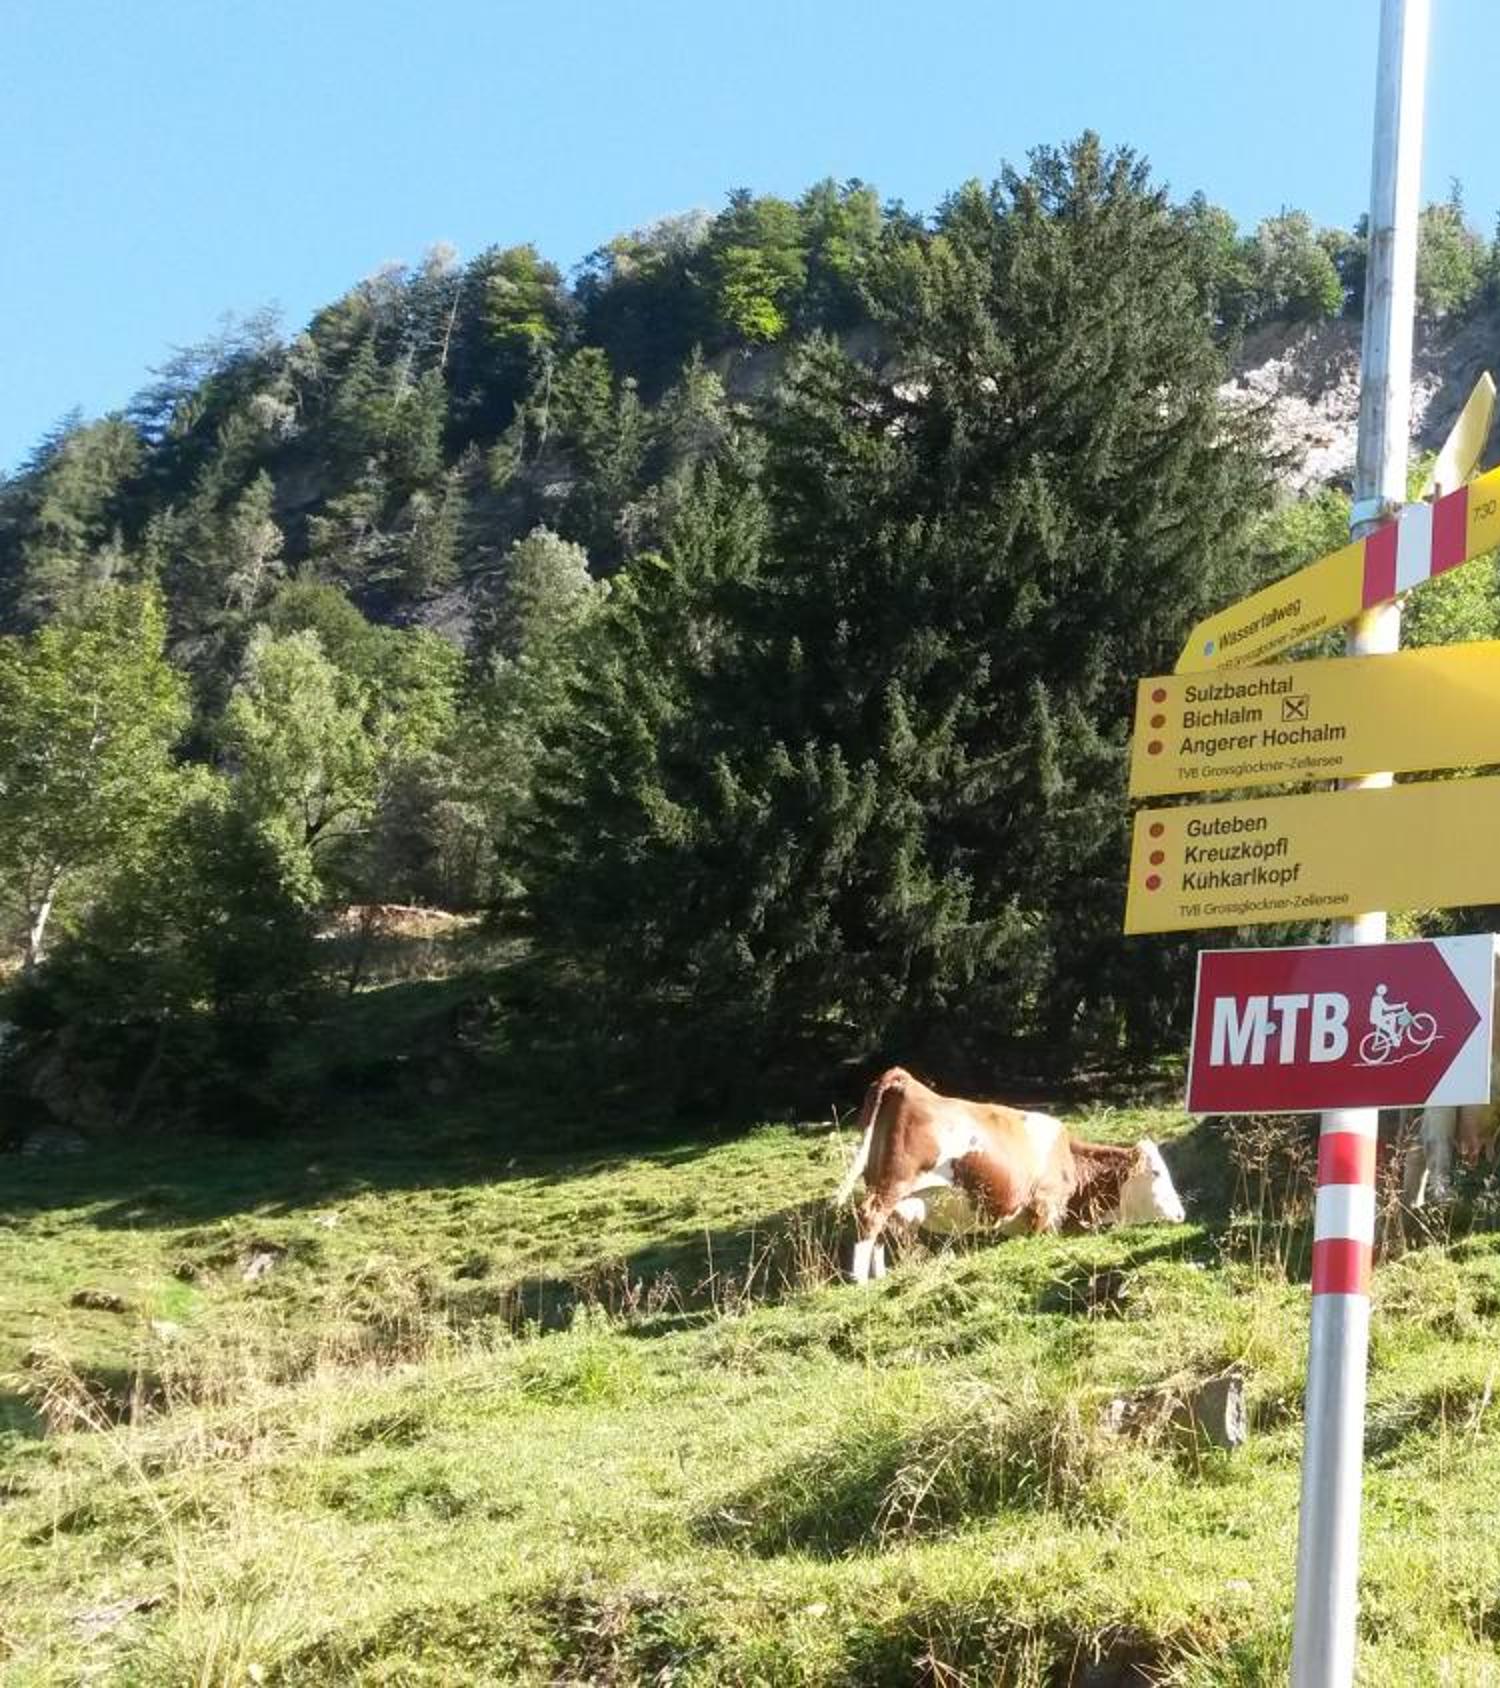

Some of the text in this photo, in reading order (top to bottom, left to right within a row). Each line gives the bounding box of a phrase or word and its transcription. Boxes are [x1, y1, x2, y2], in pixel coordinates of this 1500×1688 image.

[1219, 598, 1301, 649] Wasserfallweg
[1185, 676, 1293, 703] Sulzbachtal
[1183, 707, 1263, 728] Bichlalm
[1179, 723, 1346, 757] Angerer Hochalm
[1201, 755, 1343, 779] Grossglockner-Zellersee
[1187, 816, 1267, 837] Guteben
[1203, 893, 1349, 916] Grossglockner-Zellersee
[1209, 992, 1350, 1067] MTB
